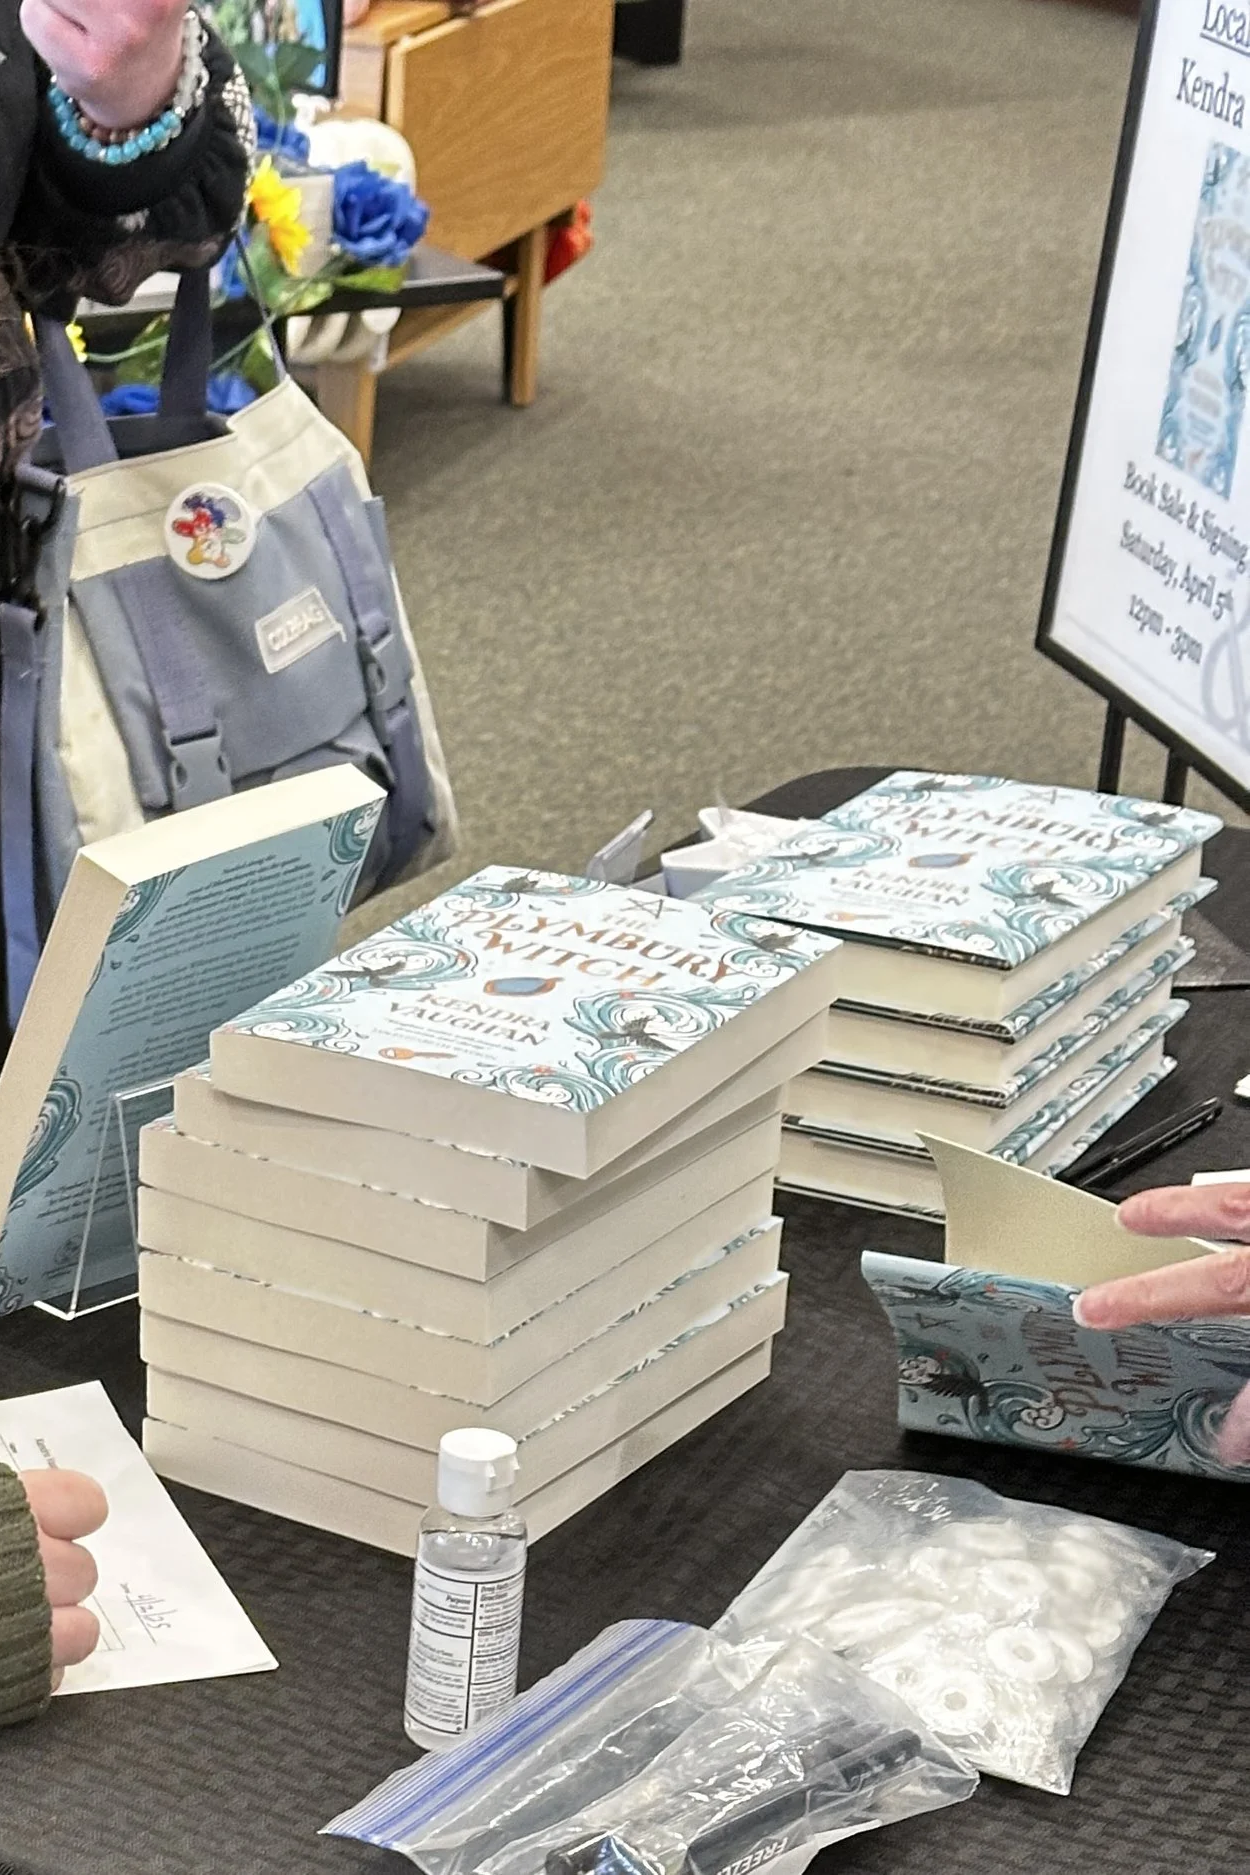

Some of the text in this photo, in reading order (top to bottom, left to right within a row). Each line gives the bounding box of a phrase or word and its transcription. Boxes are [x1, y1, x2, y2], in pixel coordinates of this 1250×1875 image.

[1203, 0, 1250, 48] Loca
[1176, 57, 1245, 128] Kendra
[1123, 461, 1249, 574] Book Sale & Signing
[1120, 520, 1179, 588] Saturday,
[1180, 563, 1215, 608] April
[1129, 594, 1164, 637] 12pm
[1171, 625, 1203, 664] 3pm
[450, 910, 750, 984] PLYMBURY
[474, 930, 667, 987] WITCH
[390, 1002, 551, 1046] VAUGHAN
[416, 993, 550, 1032] KENDRA
[716, 1837, 789, 1875] FREEZE
